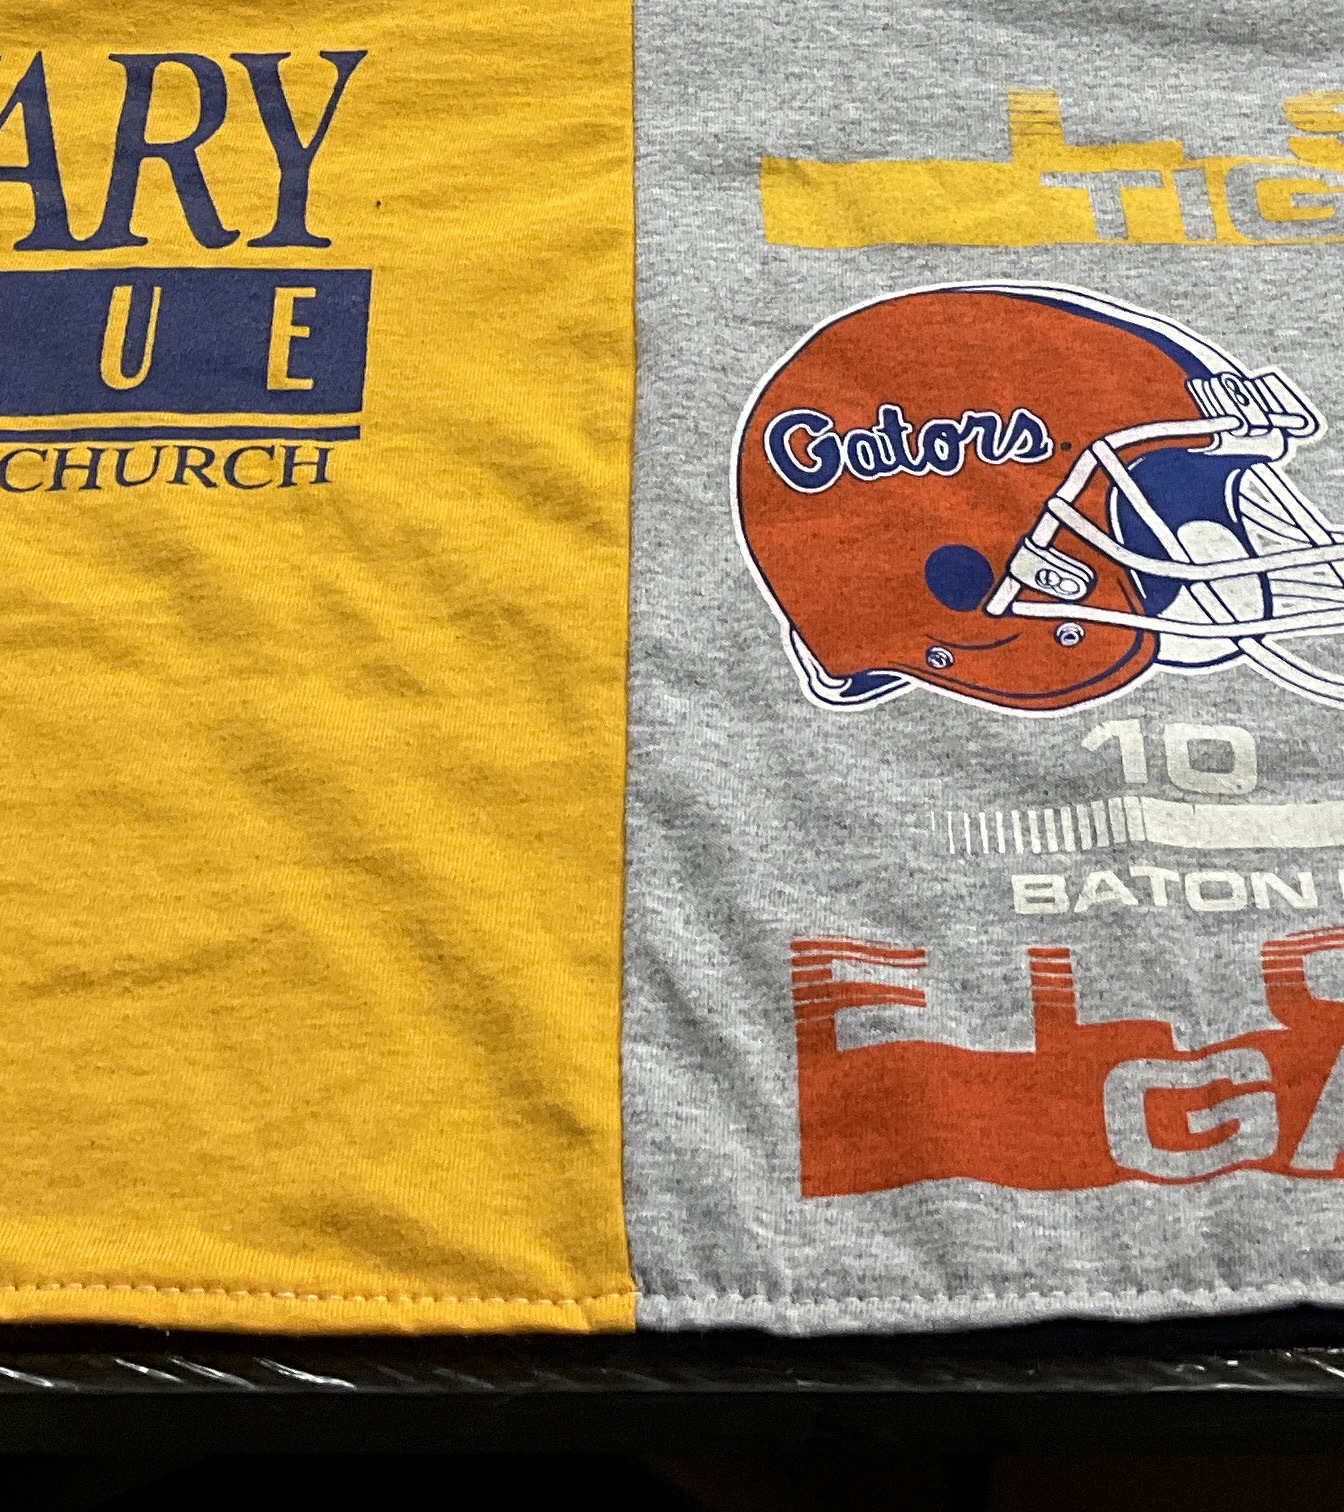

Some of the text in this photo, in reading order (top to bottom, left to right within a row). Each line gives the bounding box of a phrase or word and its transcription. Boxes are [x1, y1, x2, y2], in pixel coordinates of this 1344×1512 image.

[764, 405, 1052, 491] Gators
[1079, 718, 1256, 794] 10
[1012, 851, 1323, 916] BATON
